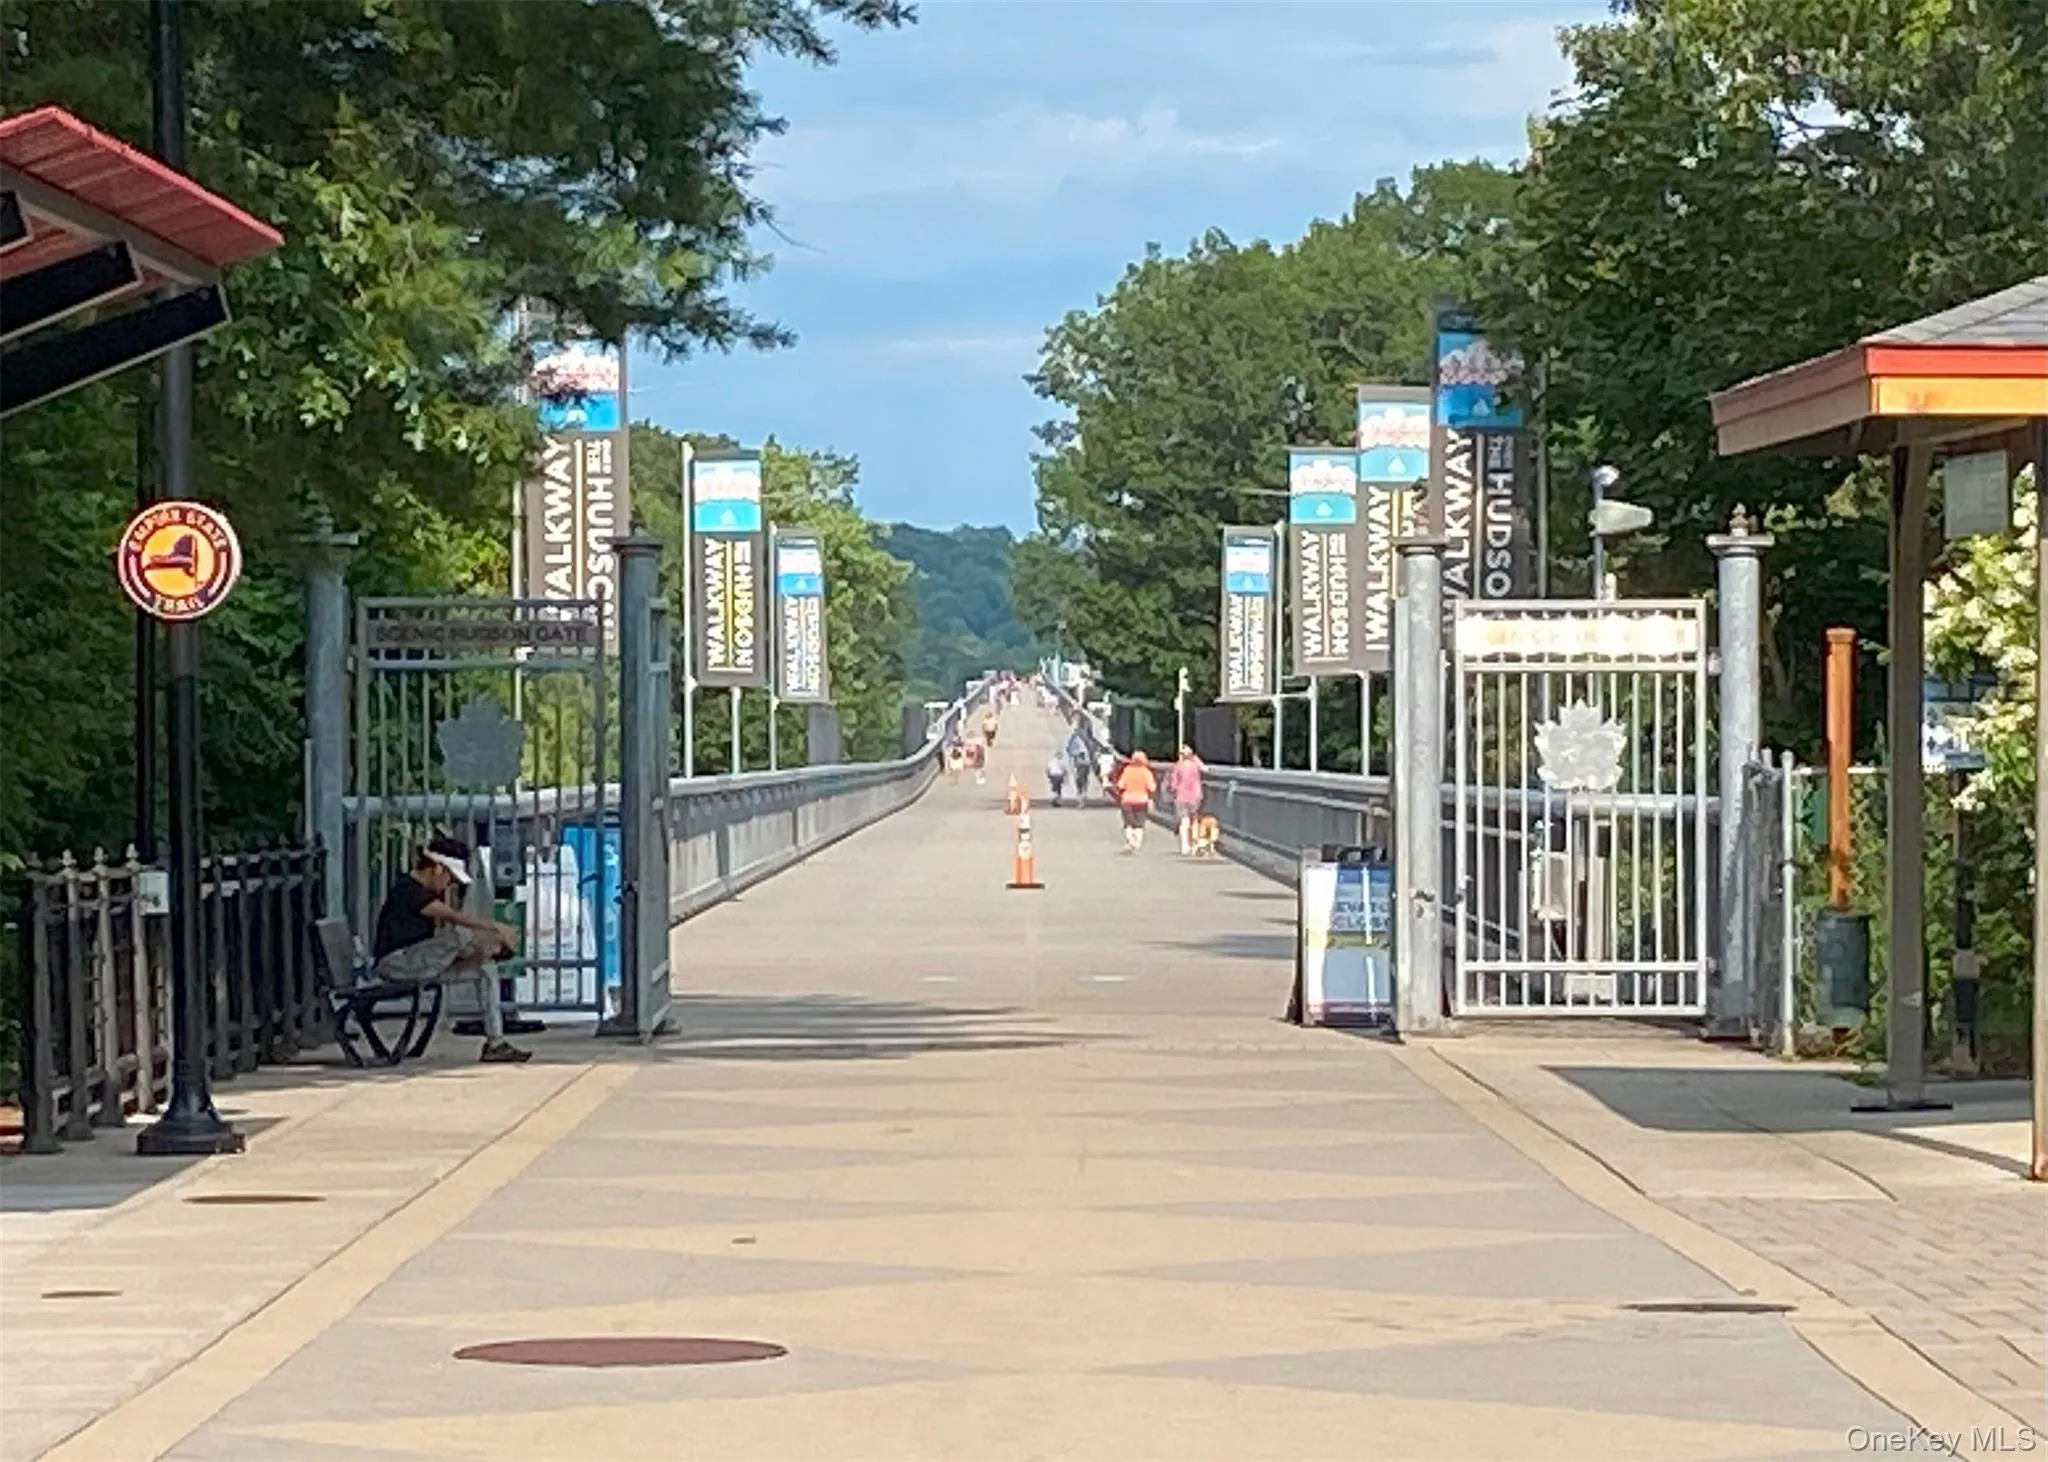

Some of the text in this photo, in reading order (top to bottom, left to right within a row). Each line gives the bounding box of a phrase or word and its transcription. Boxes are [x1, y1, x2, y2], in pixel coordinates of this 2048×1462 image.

[1301, 530, 1322, 656] WALKWAY
[1366, 486, 1391, 642] WALKWAY
[1485, 472, 1514, 598] HUDSO
[536, 624, 587, 643] GATE
[704, 538, 726, 667] WALKWAY
